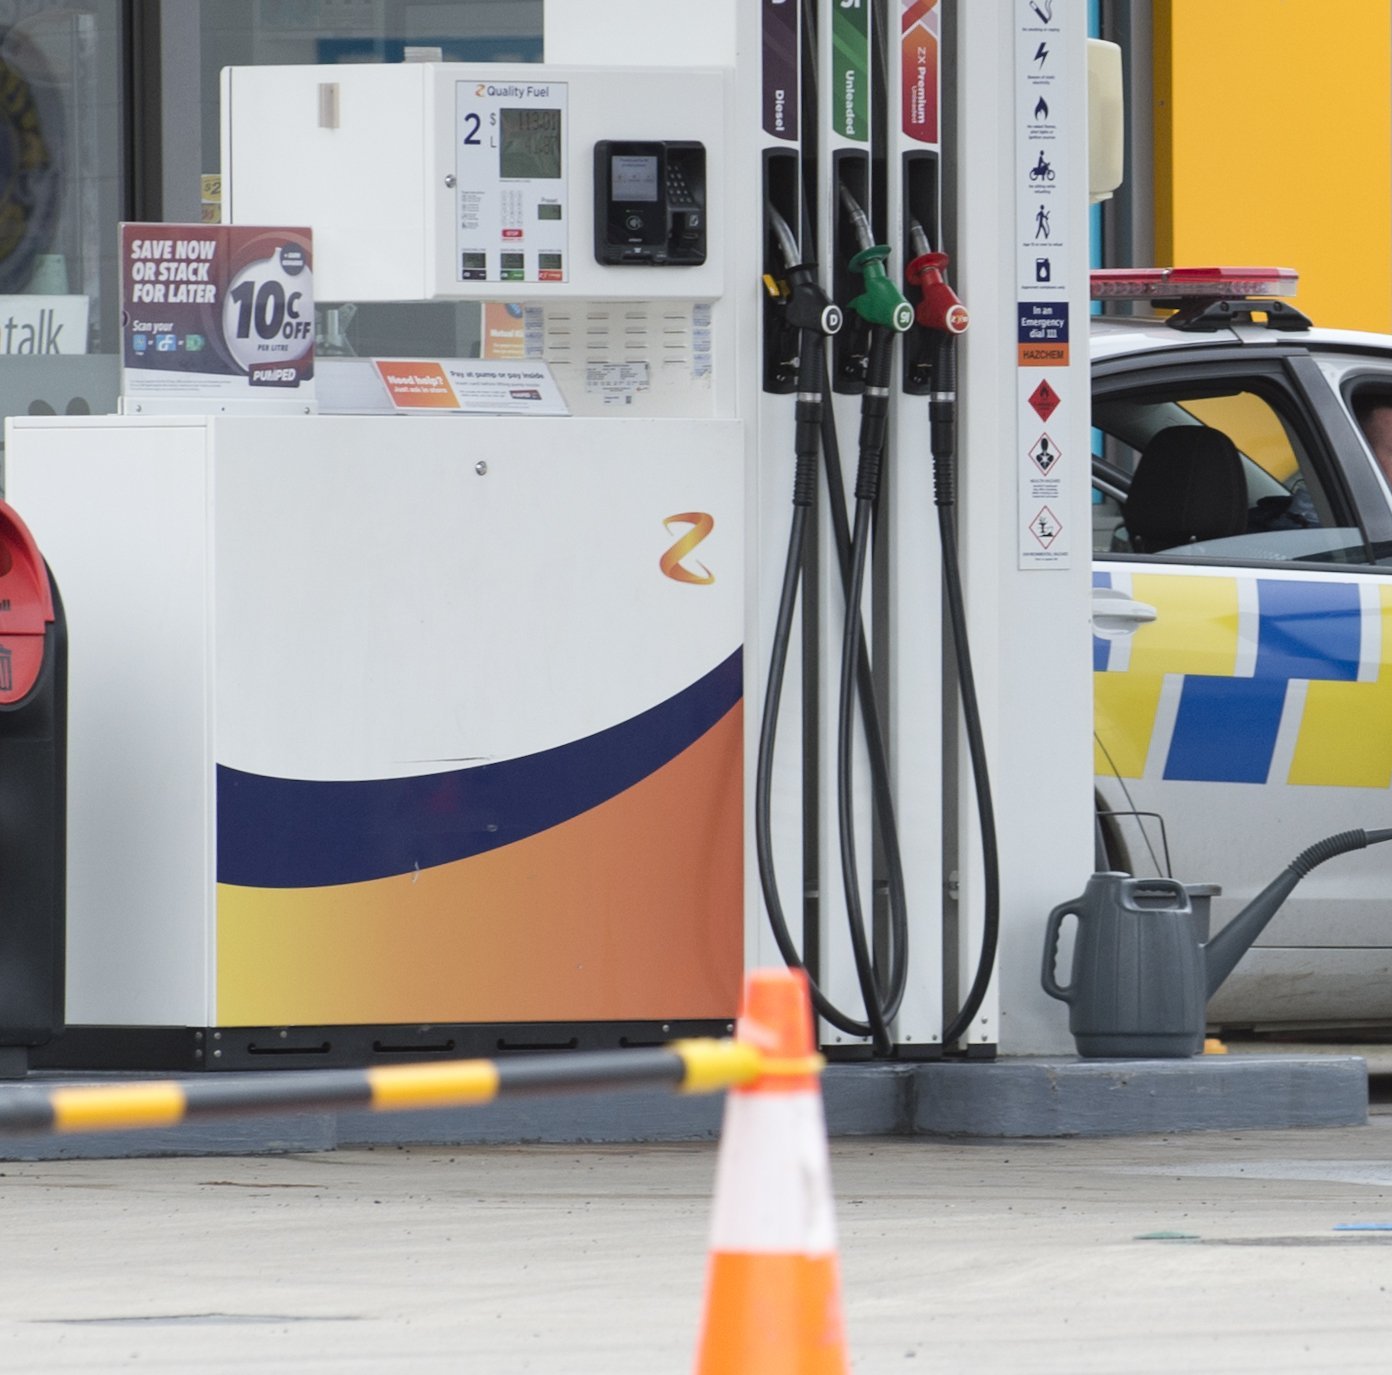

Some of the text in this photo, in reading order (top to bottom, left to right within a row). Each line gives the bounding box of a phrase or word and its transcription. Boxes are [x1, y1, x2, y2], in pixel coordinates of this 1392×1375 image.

[487, 85, 525, 99] Quality
[527, 86, 549, 97] Fuel
[917, 66, 927, 124] Premium
[845, 70, 855, 135] Unleaded
[775, 90, 785, 131] Diesel
[489, 112, 497, 126] $
[464, 112, 481, 145] 2
[490, 136, 497, 148] L
[131, 239, 216, 260] SAVE NOW
[132, 262, 210, 282] OR STACK
[132, 284, 217, 304] FOR LATER
[1033, 306, 1053, 315] In an
[132, 320, 174, 334] Scan your
[829, 314, 838, 326] D
[1021, 317, 1064, 328] Emergency
[282, 322, 311, 340] OFF
[1029, 329, 1045, 338] dial
[257, 344, 269, 352] PER
[1023, 350, 1064, 360] HAZCHEM
[253, 368, 297, 382] PUMPED
[387, 375, 414, 385] Need
[416, 376, 444, 387] help?
